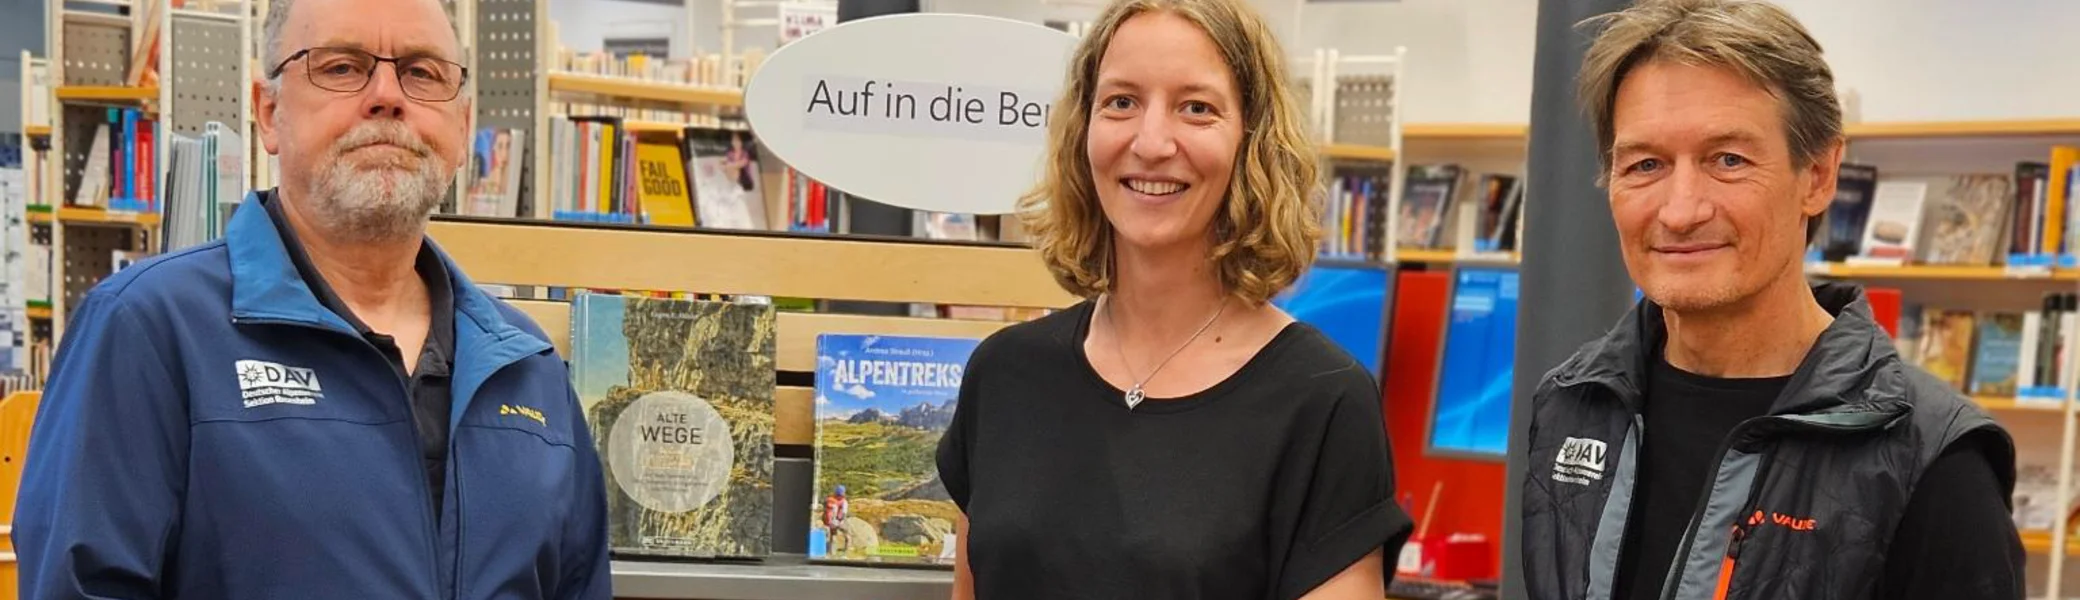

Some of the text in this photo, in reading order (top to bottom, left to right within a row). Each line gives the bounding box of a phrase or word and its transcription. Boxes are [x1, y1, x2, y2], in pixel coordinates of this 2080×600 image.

[807, 79, 876, 117] Auf
[885, 82, 916, 120] in
[929, 86, 985, 124] die
[640, 160, 670, 178] FAIL
[643, 178, 682, 197] GOOD
[263, 365, 312, 387] DAV
[834, 359, 961, 389] ALPENTREKS
[656, 412, 688, 425] ALTE
[641, 424, 703, 445] WEGE
